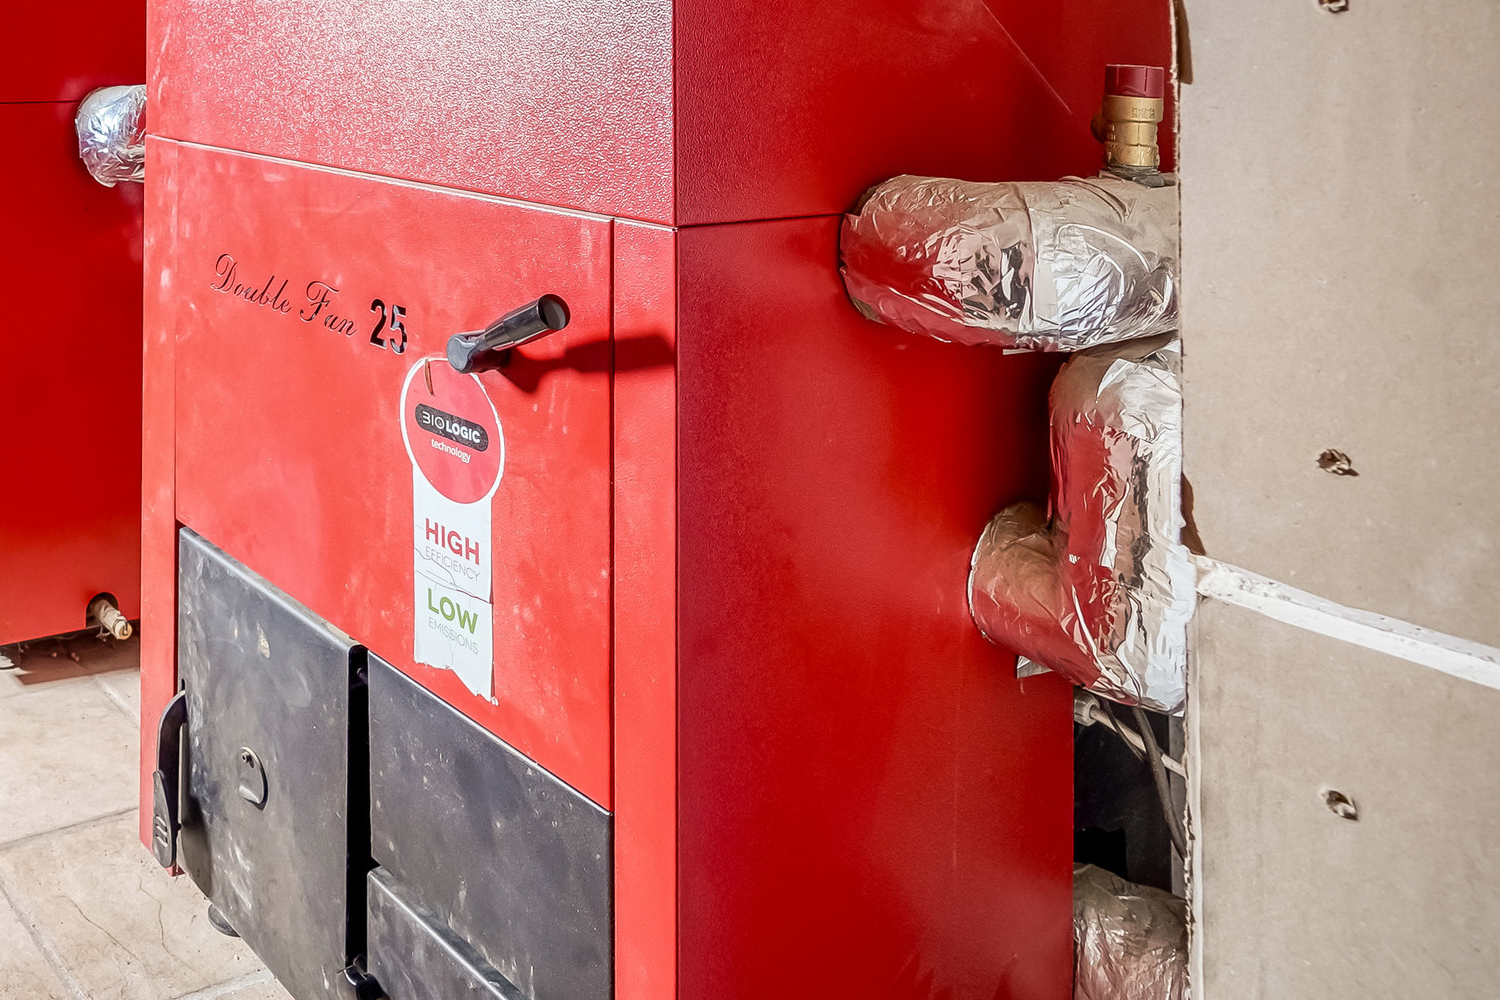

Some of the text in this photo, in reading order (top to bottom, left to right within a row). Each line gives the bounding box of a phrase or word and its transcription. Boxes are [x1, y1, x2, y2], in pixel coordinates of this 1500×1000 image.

[209, 252, 409, 356] Double Fan 25
[421, 409, 482, 445] BIOLOGIC
[430, 437, 473, 464] technology
[424, 517, 481, 566] HIGH
[425, 546, 480, 582] EFFICIENCY
[427, 587, 479, 635] LOW
[427, 616, 479, 655] EMISSIONS
